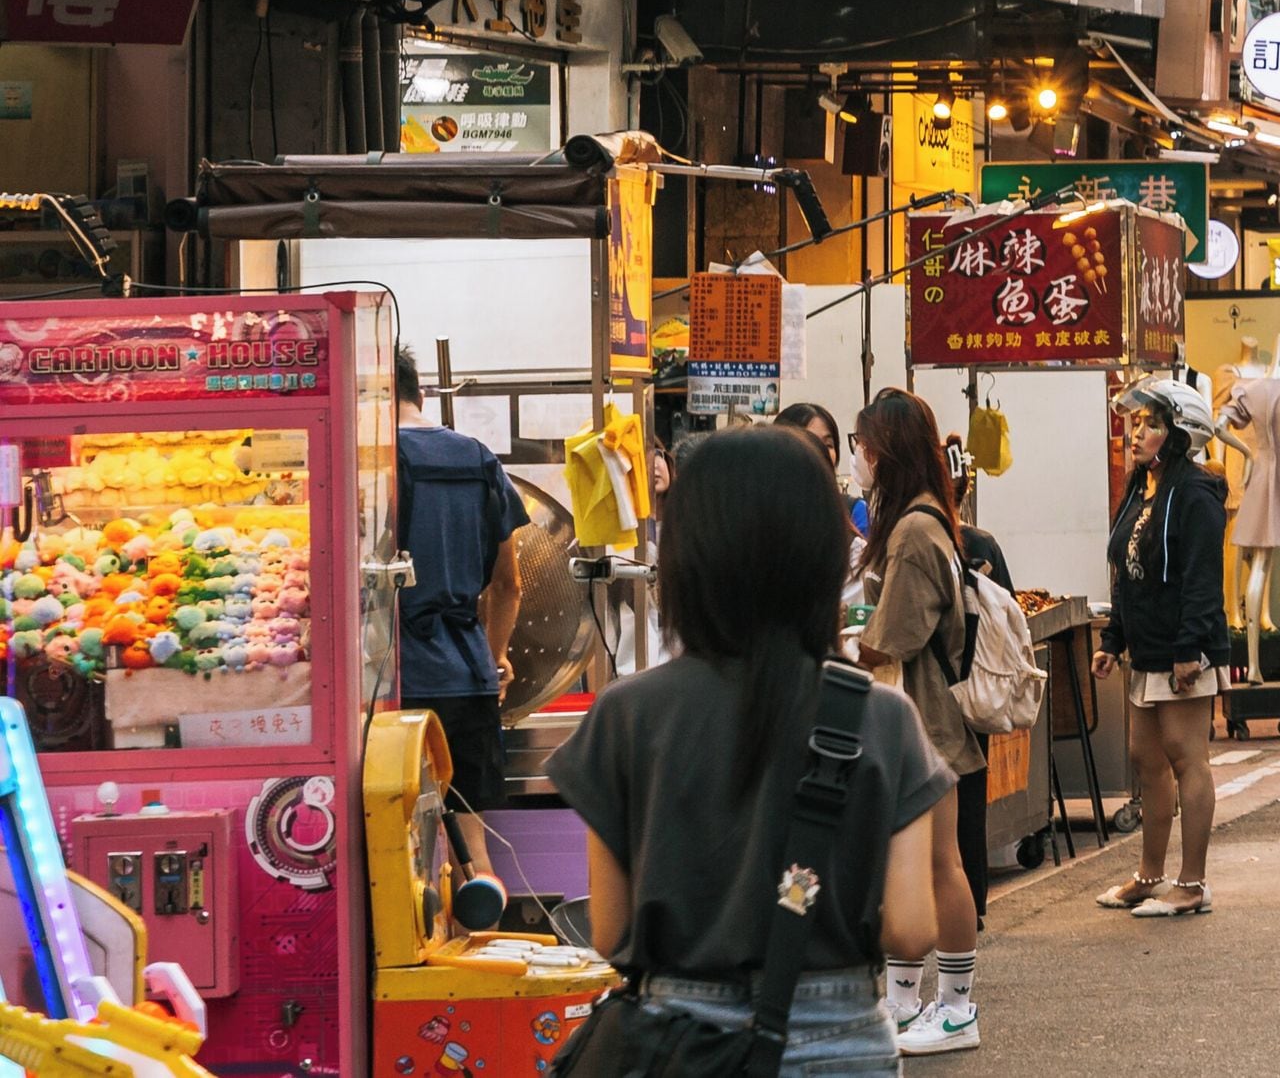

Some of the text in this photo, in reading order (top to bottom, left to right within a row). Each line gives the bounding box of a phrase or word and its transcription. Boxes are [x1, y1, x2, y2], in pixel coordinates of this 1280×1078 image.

[460, 112, 528, 128] 呼吸律動
[462, 130, 512, 139] BGM7946
[948, 227, 1045, 277] 麻辣
[995, 274, 1090, 325] 魚蛋
[29, 339, 319, 374] CARTOON HOUSE
